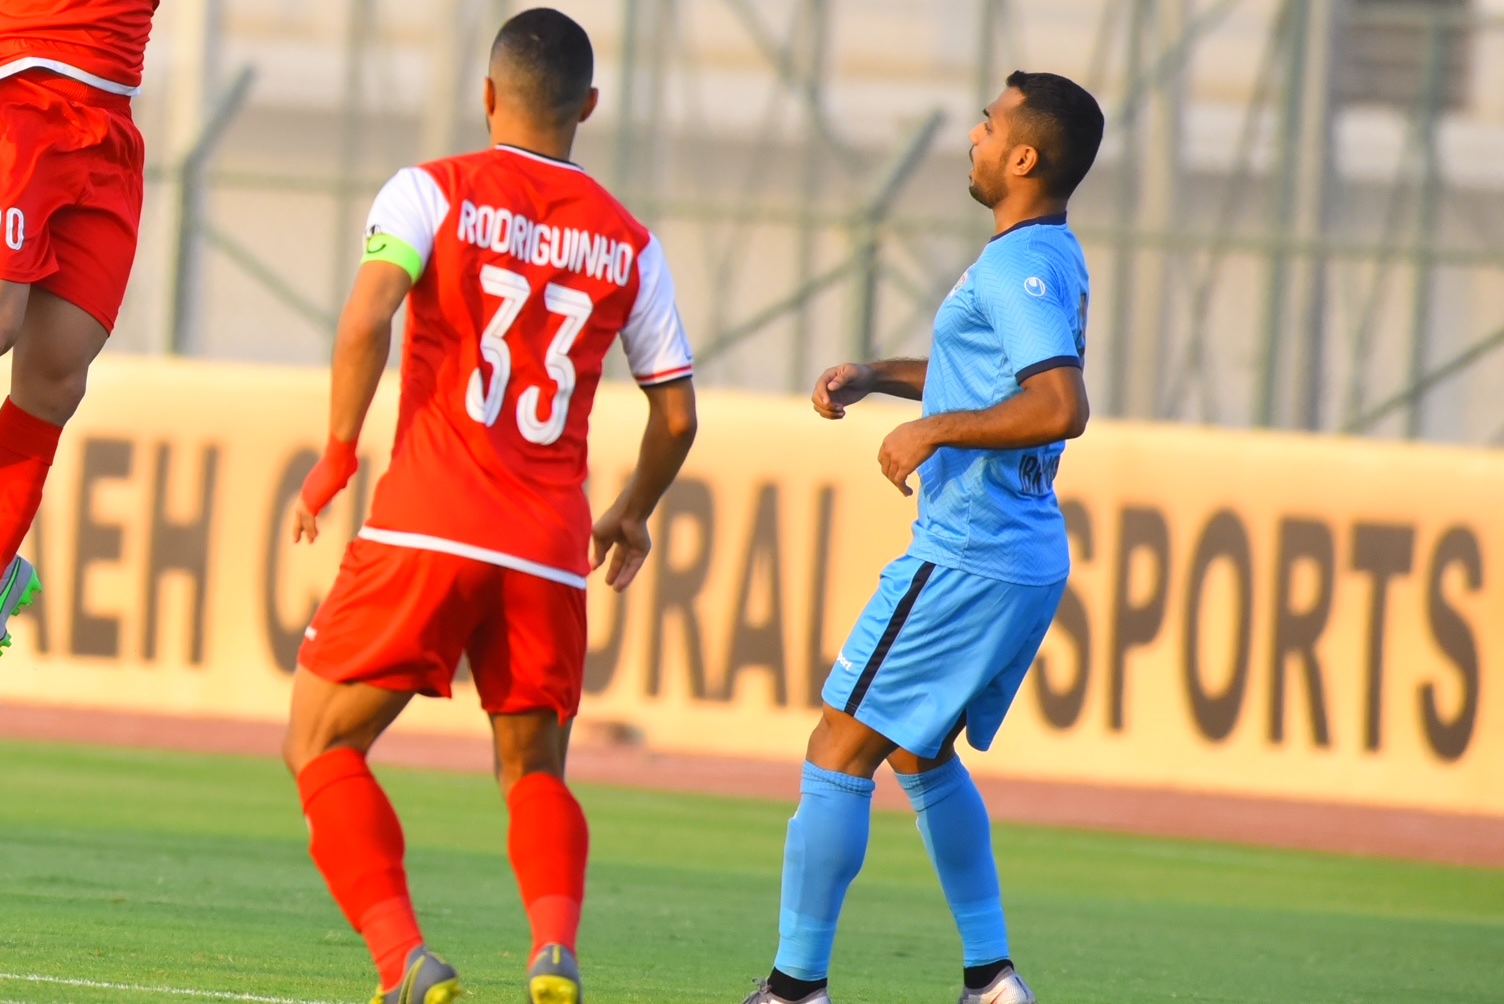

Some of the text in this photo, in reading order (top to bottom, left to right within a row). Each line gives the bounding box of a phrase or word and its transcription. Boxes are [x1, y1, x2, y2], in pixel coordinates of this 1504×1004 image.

[458, 199, 634, 286] RODRIGUINHO
[465, 263, 593, 445] 33
[1034, 501, 1484, 761] SPORTS
